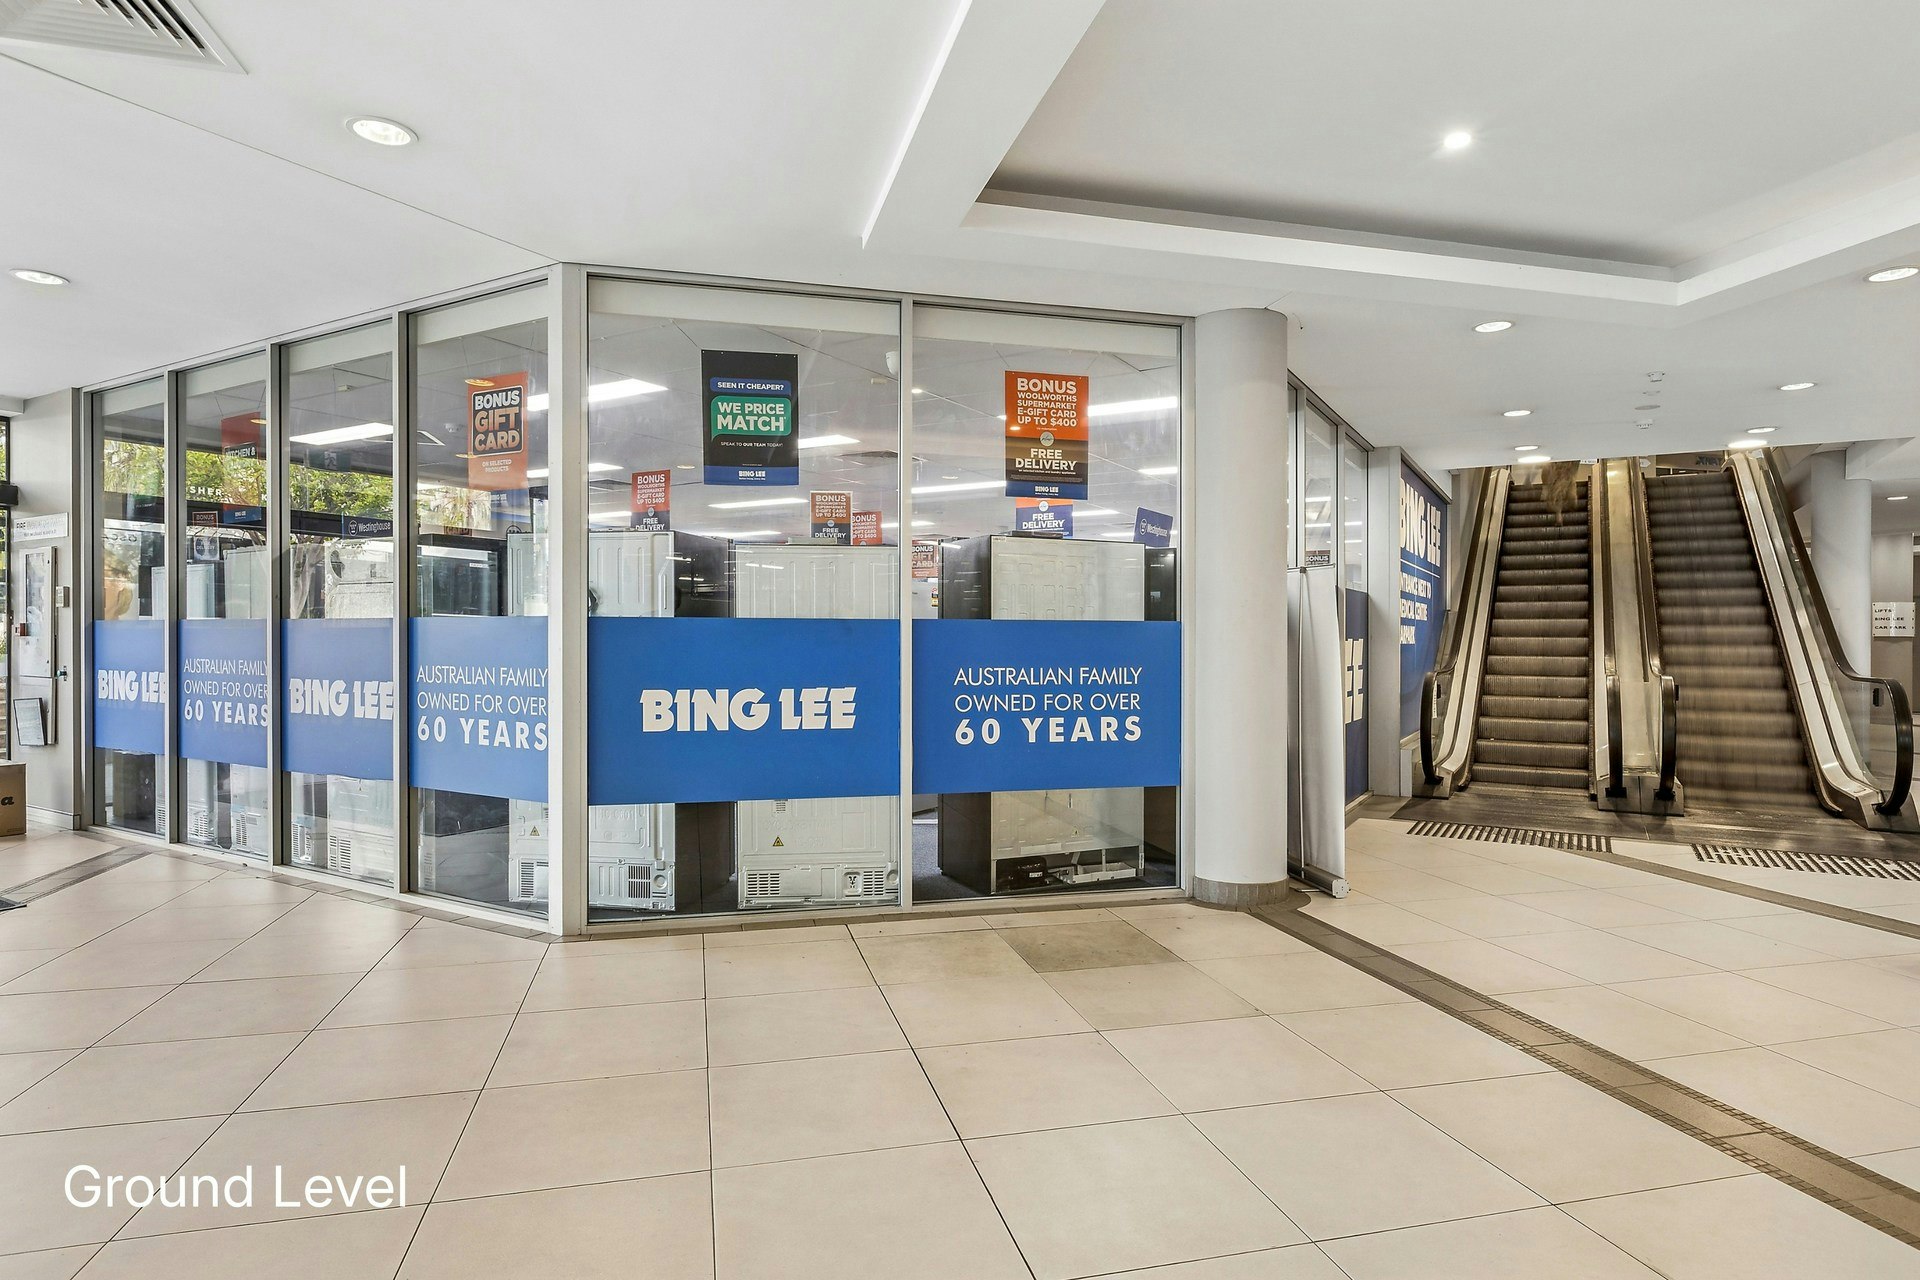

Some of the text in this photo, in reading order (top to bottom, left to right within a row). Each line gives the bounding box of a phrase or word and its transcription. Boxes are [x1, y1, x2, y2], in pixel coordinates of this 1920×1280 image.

[746, 383, 784, 391] CHEAPER?
[1017, 378, 1077, 394] BONUS
[475, 390, 520, 410] BONUS
[1017, 392, 1077, 402] WOOLWORTHS
[1017, 400, 1077, 410] SUPERMARKET
[718, 402, 784, 415] WE PRICE
[1017, 408, 1077, 418] E-GIFT CARD
[475, 407, 519, 432] GIFT
[1017, 417, 1031, 425] UP
[475, 430, 520, 452] CARD
[1030, 448, 1062, 459] FREE
[1015, 458, 1078, 471] DELIVERY
[637, 474, 666, 485] BONUS
[815, 494, 846, 502] BONUS
[1022, 519, 1065, 529] DELIVERY
[1032, 512, 1054, 521] FREE
[1400, 477, 1441, 568] BING LEE
[358, 522, 391, 533] Westinghouse
[912, 560, 933, 568] CARD
[183, 658, 236, 675] AUSTRALIAN
[416, 664, 548, 688] AUSTRALIAN FAMILY
[953, 666, 1142, 687] AUSTRALIAN FAMILY
[98, 669, 139, 702] BING
[184, 679, 268, 699] OWNED FOR OVER
[289, 678, 394, 721] BING LEE
[417, 691, 547, 716] OWNED FOR OVER
[955, 692, 1141, 713] OWNED FOR OVER
[184, 700, 268, 727] 60 YEARS
[639, 687, 856, 732] BING LEE
[417, 715, 548, 751] 60 YEARS
[955, 716, 1142, 746] 60 YEARS
